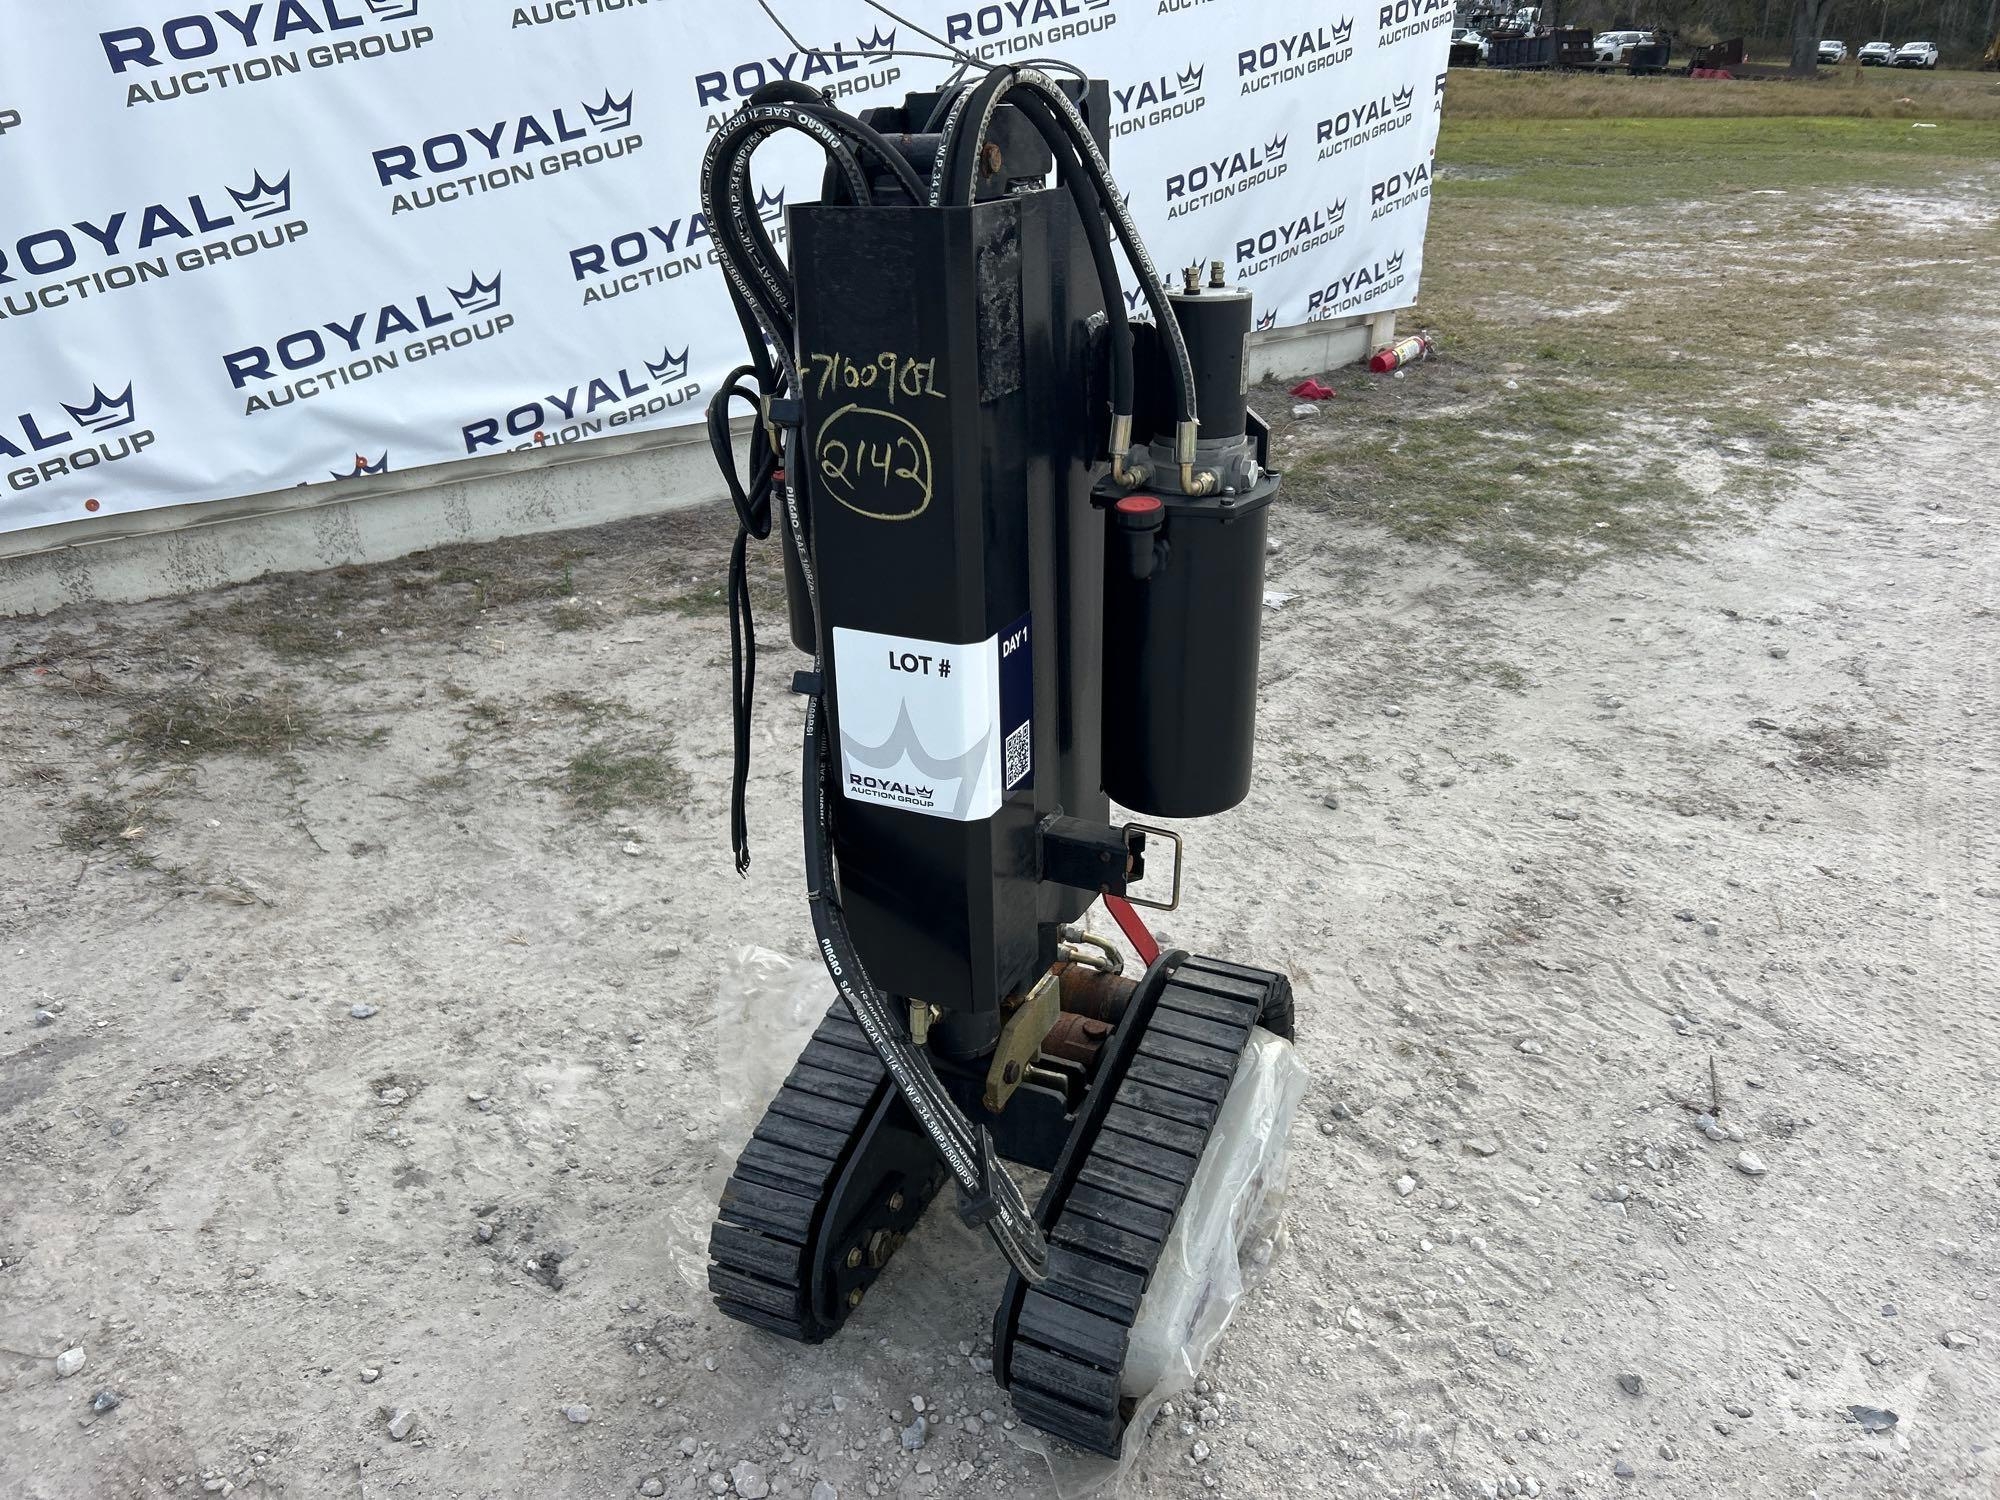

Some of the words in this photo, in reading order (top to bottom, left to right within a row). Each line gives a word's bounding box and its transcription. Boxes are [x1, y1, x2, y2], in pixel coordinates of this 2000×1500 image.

[99, 0, 365, 74] ROYAL
[947, 0, 1080, 45] ROYAL
[1047, 13, 1117, 43] GROUP
[1378, 19, 1430, 48] AUCTION
[126, 52, 301, 108] AUCTION
[307, 26, 434, 69] GROUP
[695, 42, 859, 107] ROYAL
[1238, 27, 1331, 77] ROYAL
[1240, 62, 1305, 96] AUCTION
[1307, 47, 1353, 74] GROUP
[821, 67, 901, 100] GROUP
[1113, 76, 1177, 114] YAL
[765, 107, 791, 118] SAE
[1149, 96, 1206, 126] GROUP
[1316, 96, 1392, 145] ROYAL
[1317, 129, 1371, 162] AUCTION
[1372, 112, 1412, 141] GROUP
[372, 109, 588, 187] ROYAL
[1165, 146, 1263, 202] ROYAL
[391, 162, 535, 216] AUCTION
[540, 134, 644, 177] GROUP
[1167, 183, 1236, 221] AUCTION
[1238, 164, 1288, 194] GROUP
[1371, 190, 1419, 221] AUCTION
[0, 194, 235, 285] OYAL
[568, 212, 712, 282] ROYA
[1235, 210, 1326, 263] ROYAL
[1237, 244, 1299, 281] AUCTION
[1301, 224, 1346, 254] GROUP
[0, 256, 170, 319] UCTION
[175, 219, 310, 273] GROUP
[583, 253, 703, 306] AUCTION
[1307, 262, 1385, 313] ROYAL
[1306, 294, 1362, 323] AUCTION
[1364, 274, 1405, 302] GROUP
[222, 295, 454, 389] ROYAL
[245, 351, 400, 416] AUCTION
[404, 313, 515, 363] GROUP
[461, 369, 649, 454] ROYAL
[609, 383, 702, 428] GROUP
[7, 429, 156, 491] GROUP
[821, 436, 928, 491] 2142
[889, 650, 933, 675] LOT
[938, 658, 951, 678] #
[1002, 631, 1022, 658] DAY
[1022, 626, 1028, 643] 1
[850, 773, 916, 797] ROYAL
[851, 786, 896, 801] AUCTION
[897, 794, 935, 808] GROUP
[918, 1106, 975, 1188] 34.5MPa/5000PSI
